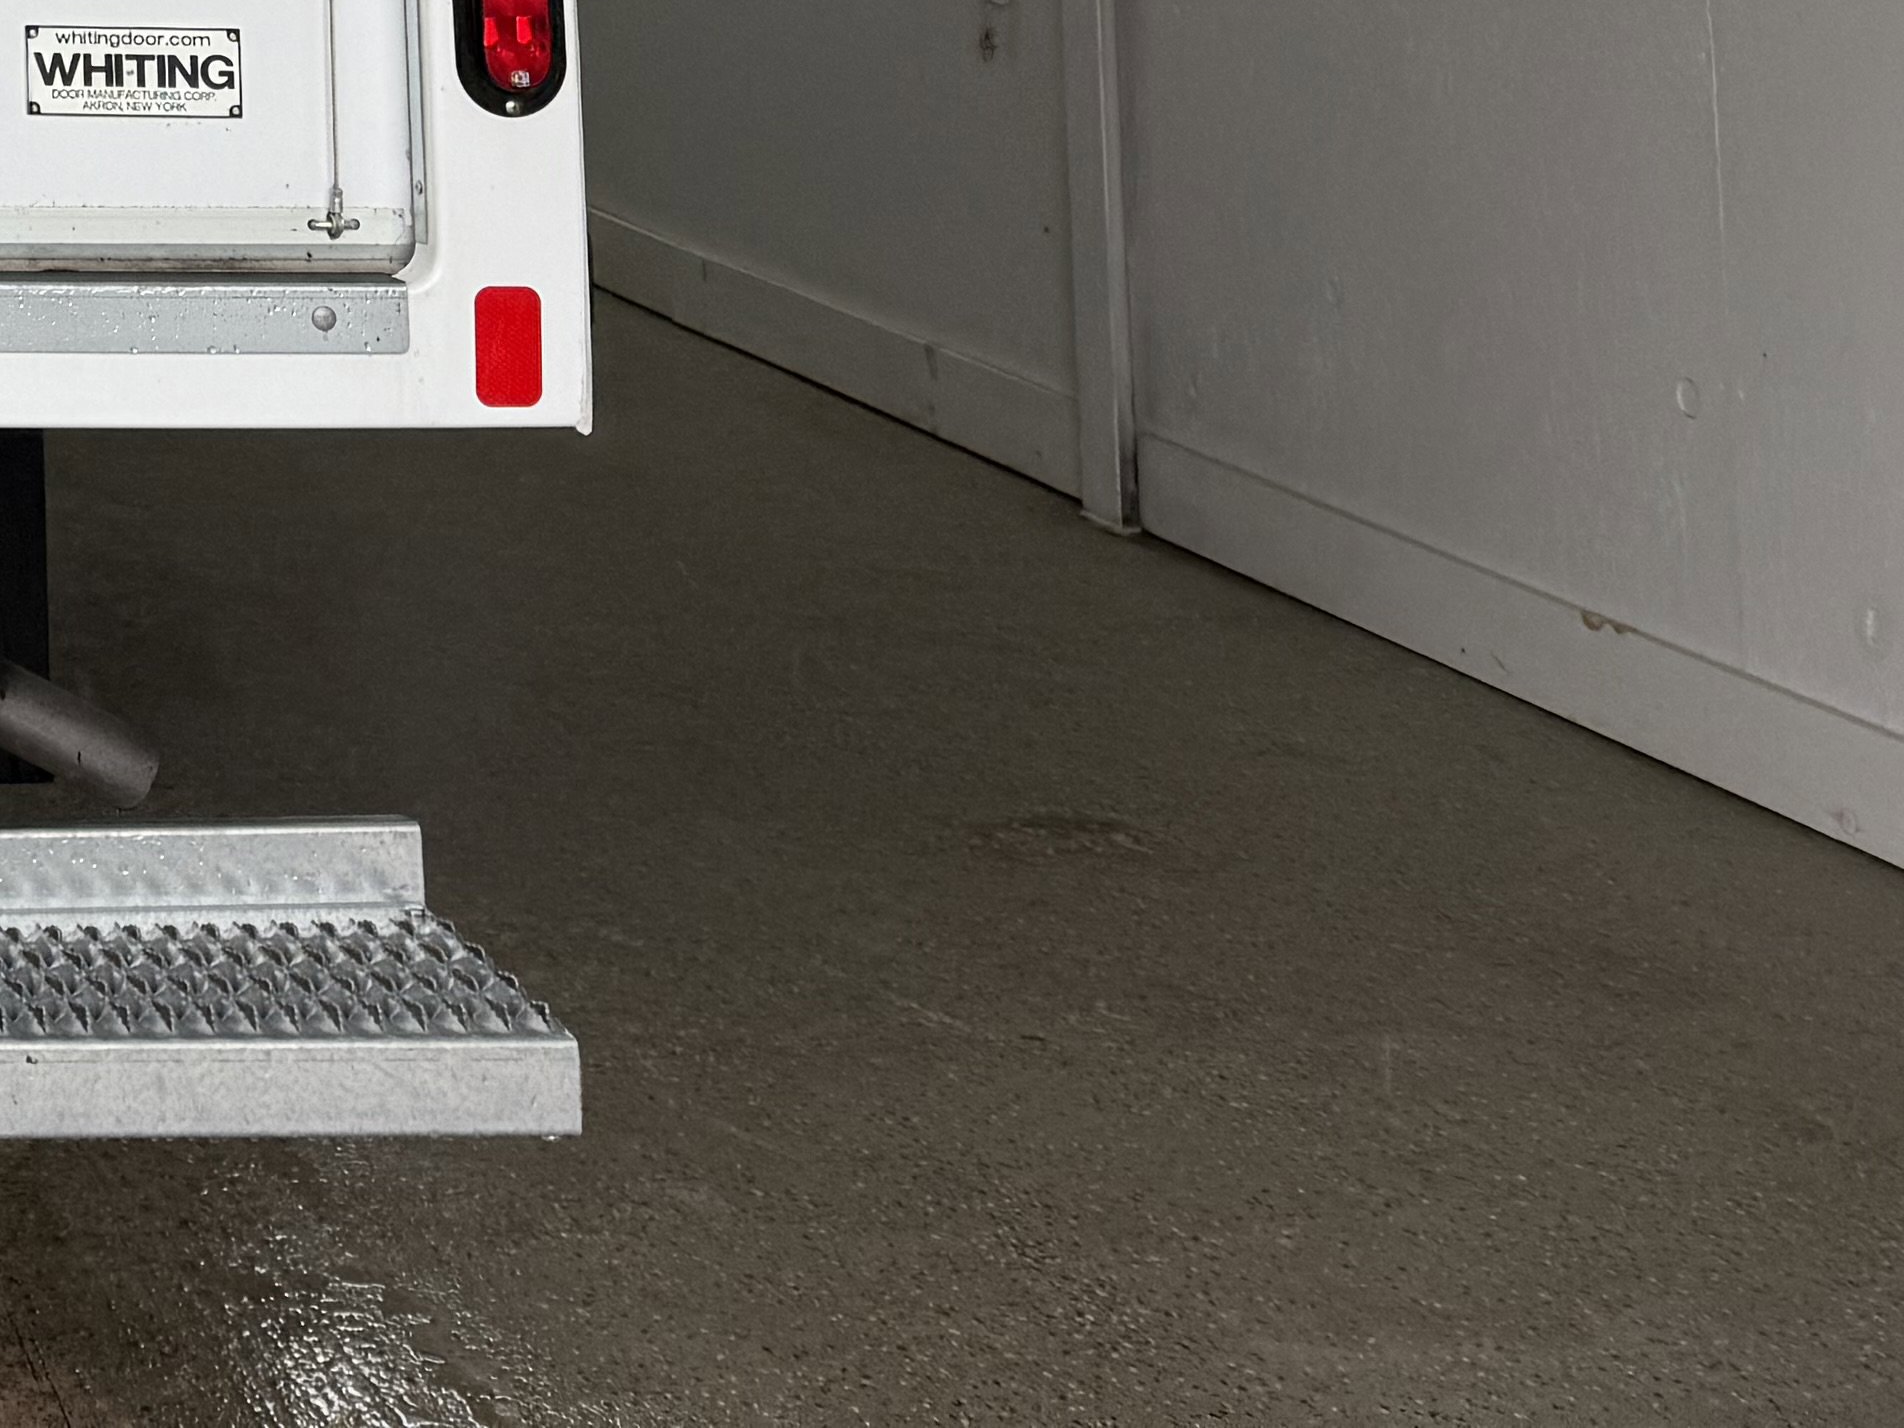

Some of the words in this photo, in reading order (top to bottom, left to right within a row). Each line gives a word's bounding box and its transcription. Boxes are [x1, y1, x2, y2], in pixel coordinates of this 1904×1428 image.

[55, 31, 211, 48] whitingdoor.com
[34, 52, 235, 90] WHITING
[52, 89, 85, 99] DOOR
[87, 90, 181, 101] MANUFACTURING
[126, 102, 153, 112] NEW
[156, 102, 187, 112] YORK
